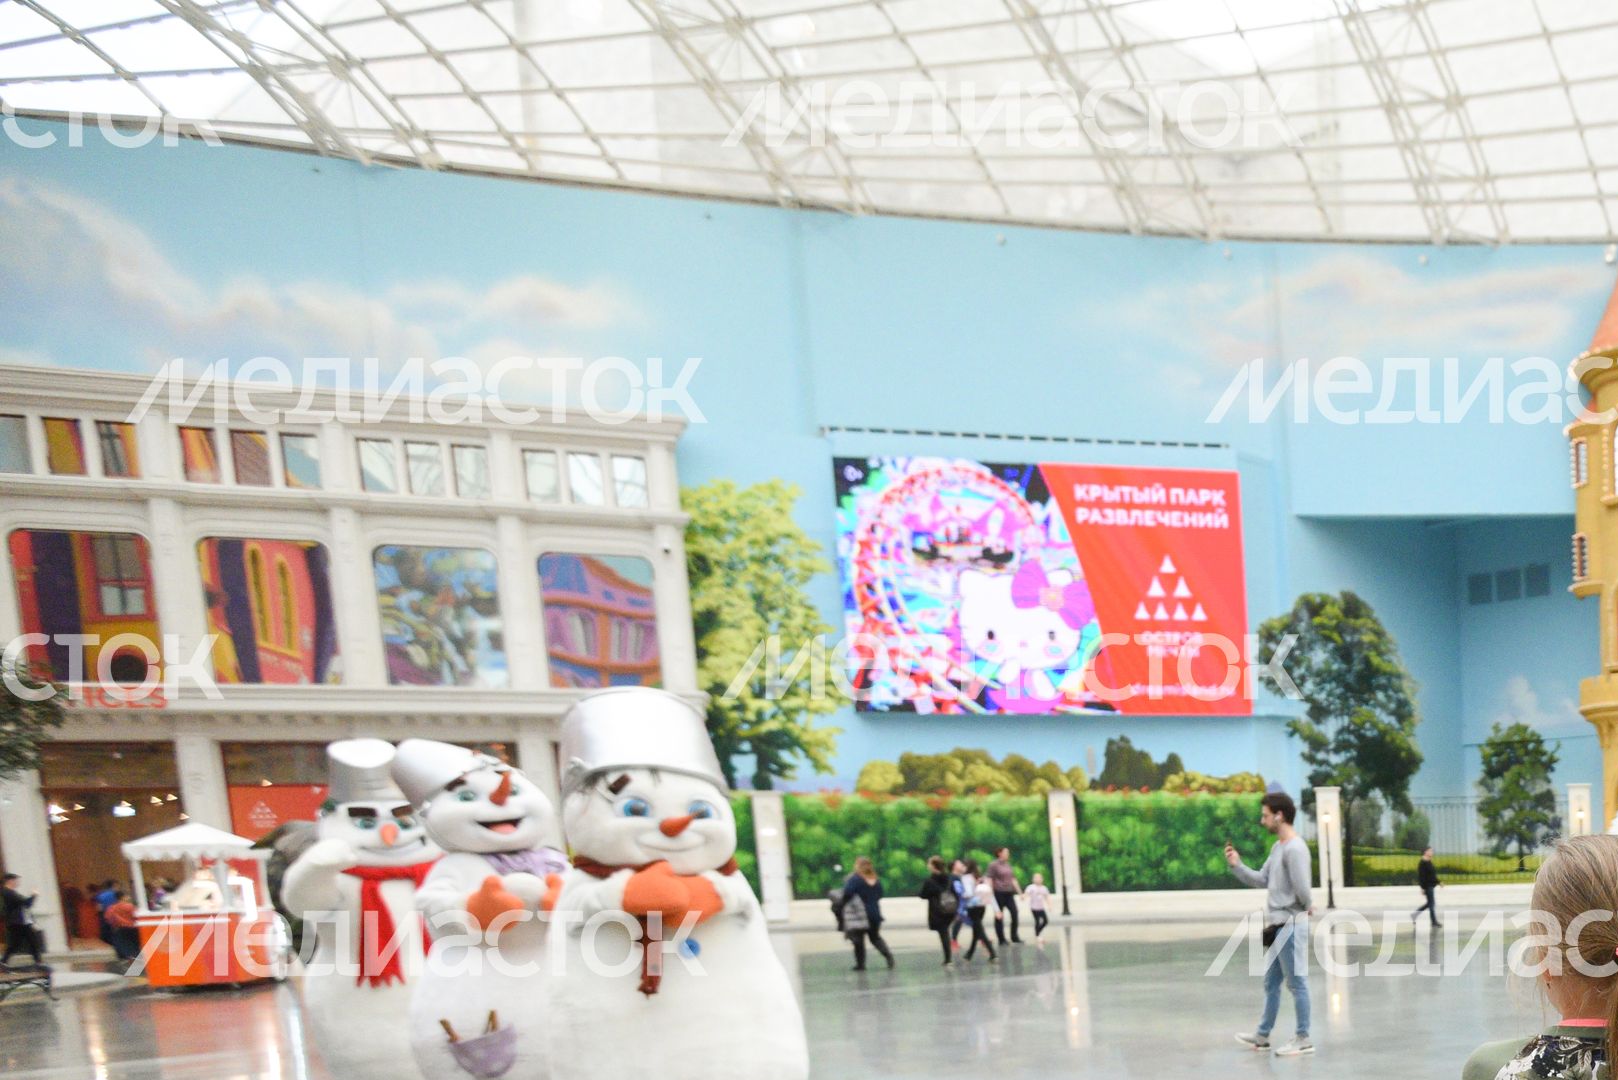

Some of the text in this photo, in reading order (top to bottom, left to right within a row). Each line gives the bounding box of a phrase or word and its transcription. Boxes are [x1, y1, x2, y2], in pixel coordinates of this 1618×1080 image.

[1074, 482, 1227, 506] КРЫТЫЙ ПАРК
[1075, 507, 1229, 529] РАЗВЛЕЧЕНИЙ
